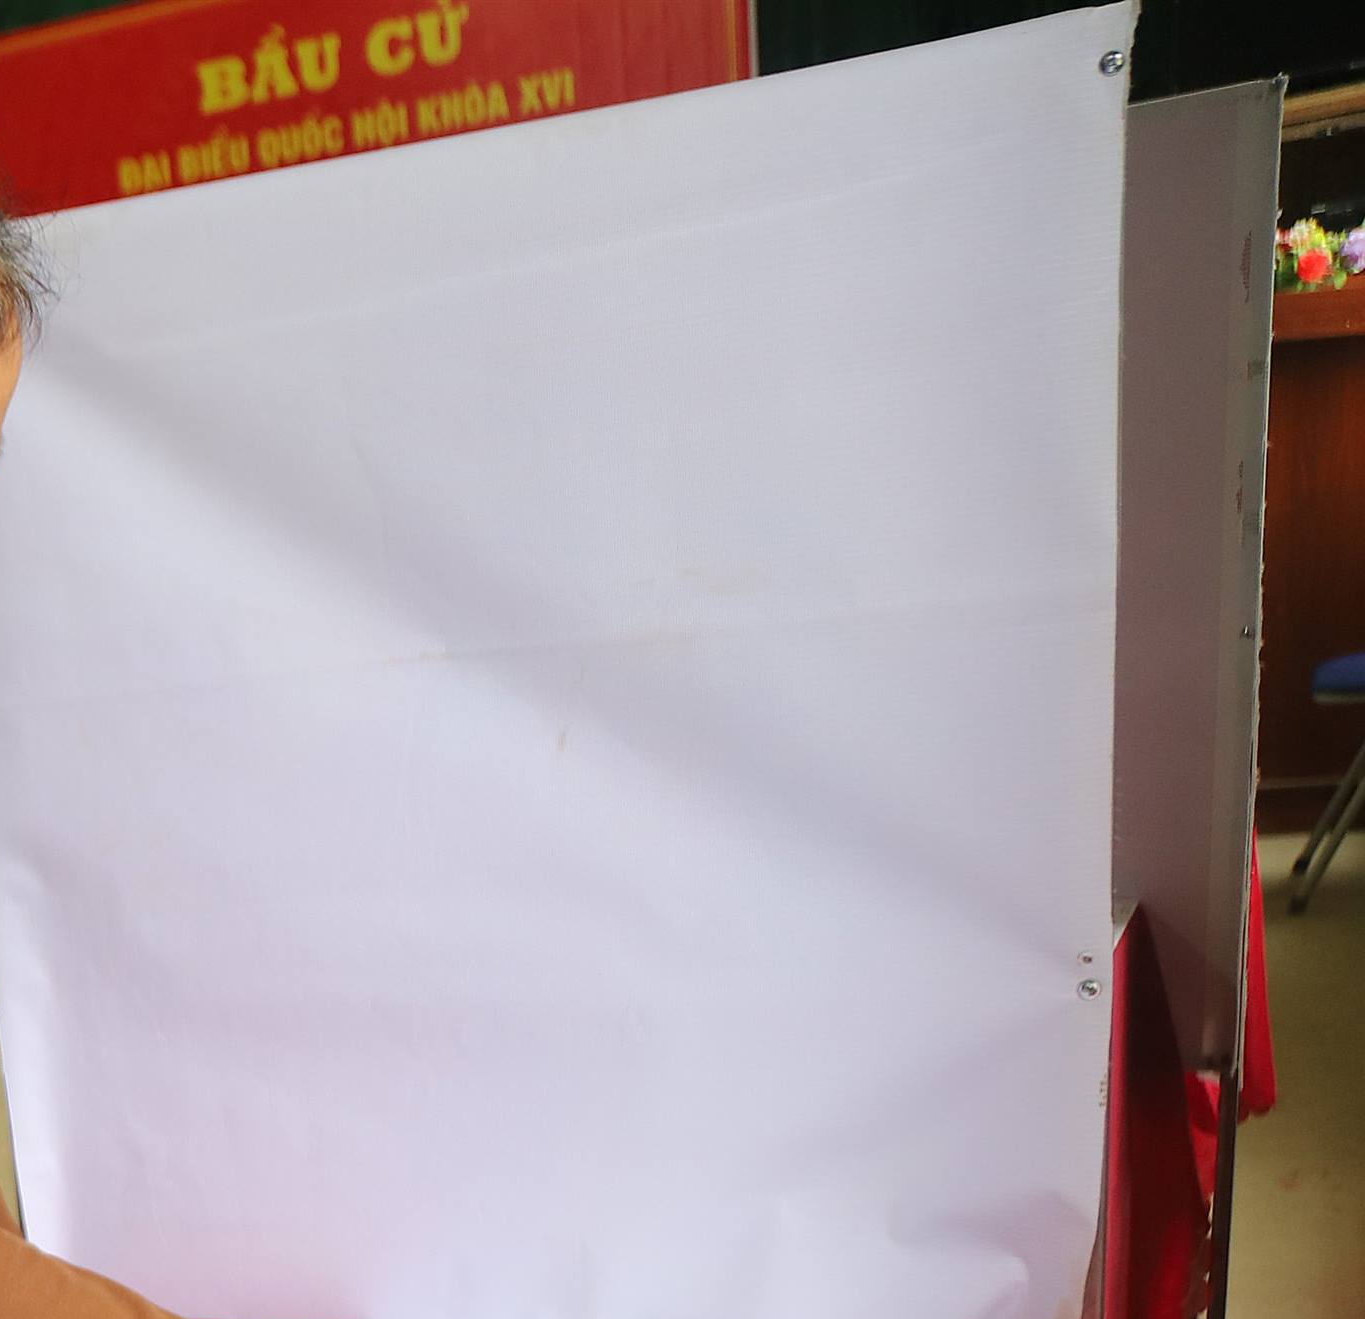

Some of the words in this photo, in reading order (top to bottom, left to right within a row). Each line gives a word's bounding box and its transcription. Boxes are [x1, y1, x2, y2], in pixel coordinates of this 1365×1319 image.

[197, 25, 341, 114] BẦU
[367, 0, 469, 76] CỬ
[179, 127, 251, 185] BIỂU
[257, 114, 346, 170] QUỐC
[351, 100, 410, 147] HỘI
[416, 79, 510, 133] KHÓA
[519, 67, 576, 115] XVI
